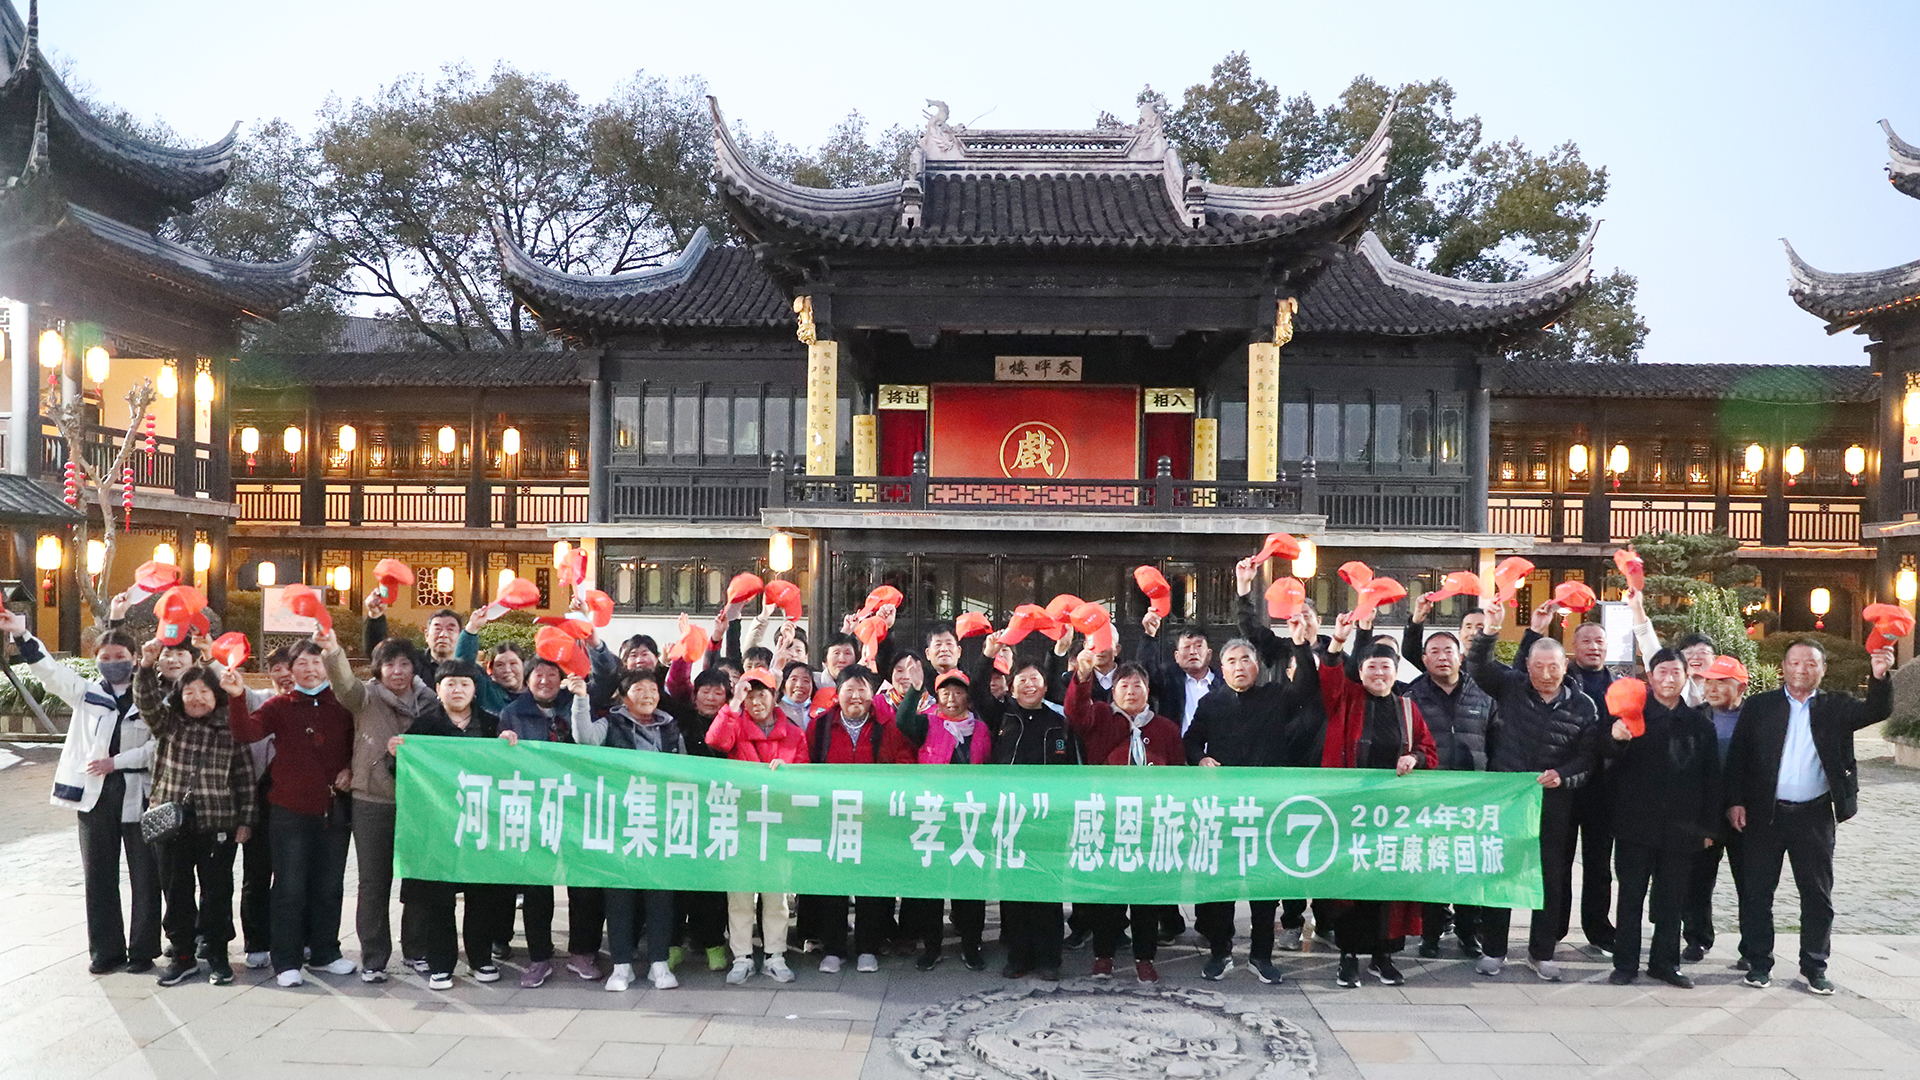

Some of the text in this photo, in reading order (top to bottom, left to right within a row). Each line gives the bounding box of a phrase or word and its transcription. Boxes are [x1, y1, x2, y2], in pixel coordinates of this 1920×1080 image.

[1351, 804, 1500, 831] 2024年3月
[1348, 833, 1504, 874] 长垣康辉国旅
